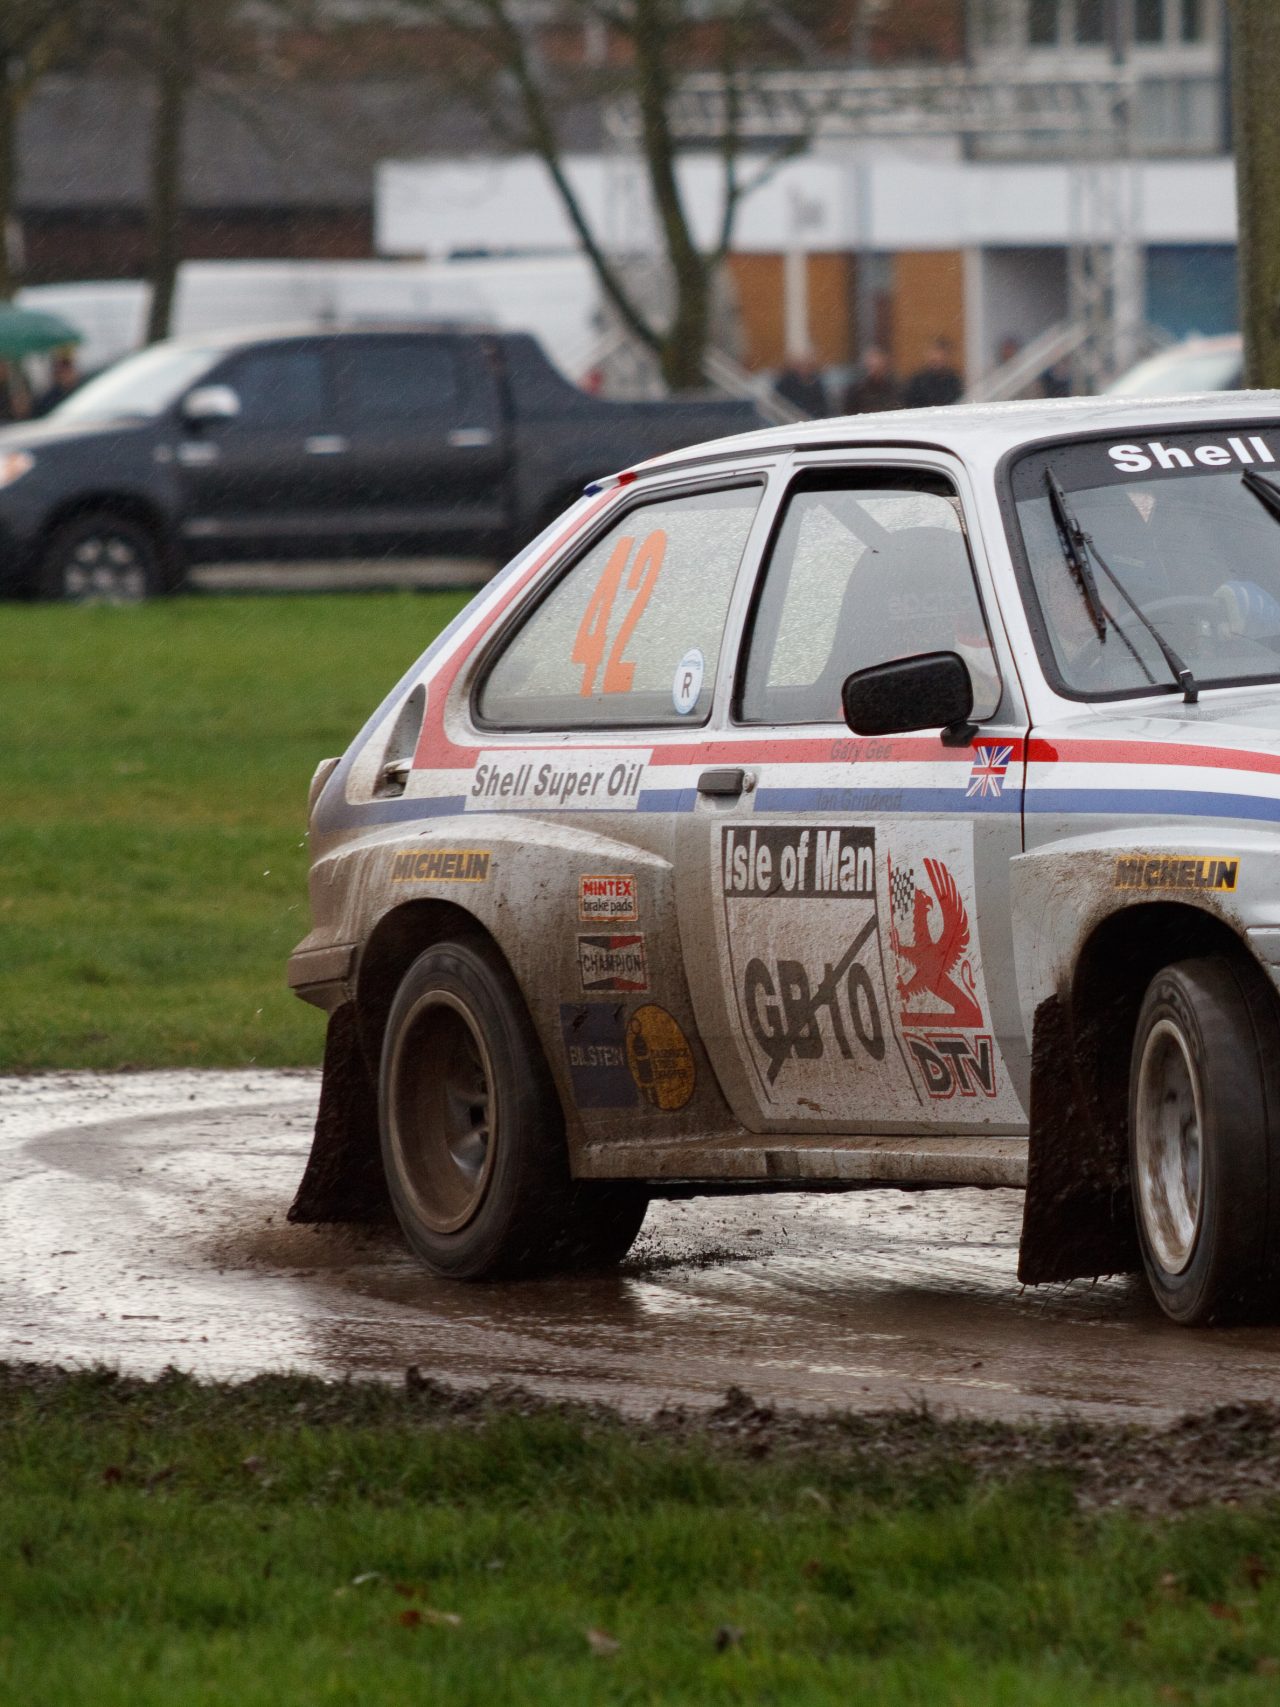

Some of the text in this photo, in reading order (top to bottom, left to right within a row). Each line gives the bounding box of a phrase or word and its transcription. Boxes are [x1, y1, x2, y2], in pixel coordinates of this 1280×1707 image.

[1108, 436, 1275, 473] Shell
[571, 529, 667, 697] 42
[681, 671, 693, 698] R
[472, 763, 644, 805] Shell Super Oil
[391, 853, 490, 879] MICHELIN
[725, 829, 874, 892] Isle of Man
[1115, 860, 1238, 888] MICHELIN
[583, 880, 632, 897] MINTEX
[583, 899, 633, 914] brake pads
[582, 954, 641, 973] CHAMPION
[569, 1046, 624, 1067] BILSTEIN
[904, 1032, 996, 1099] DTV
